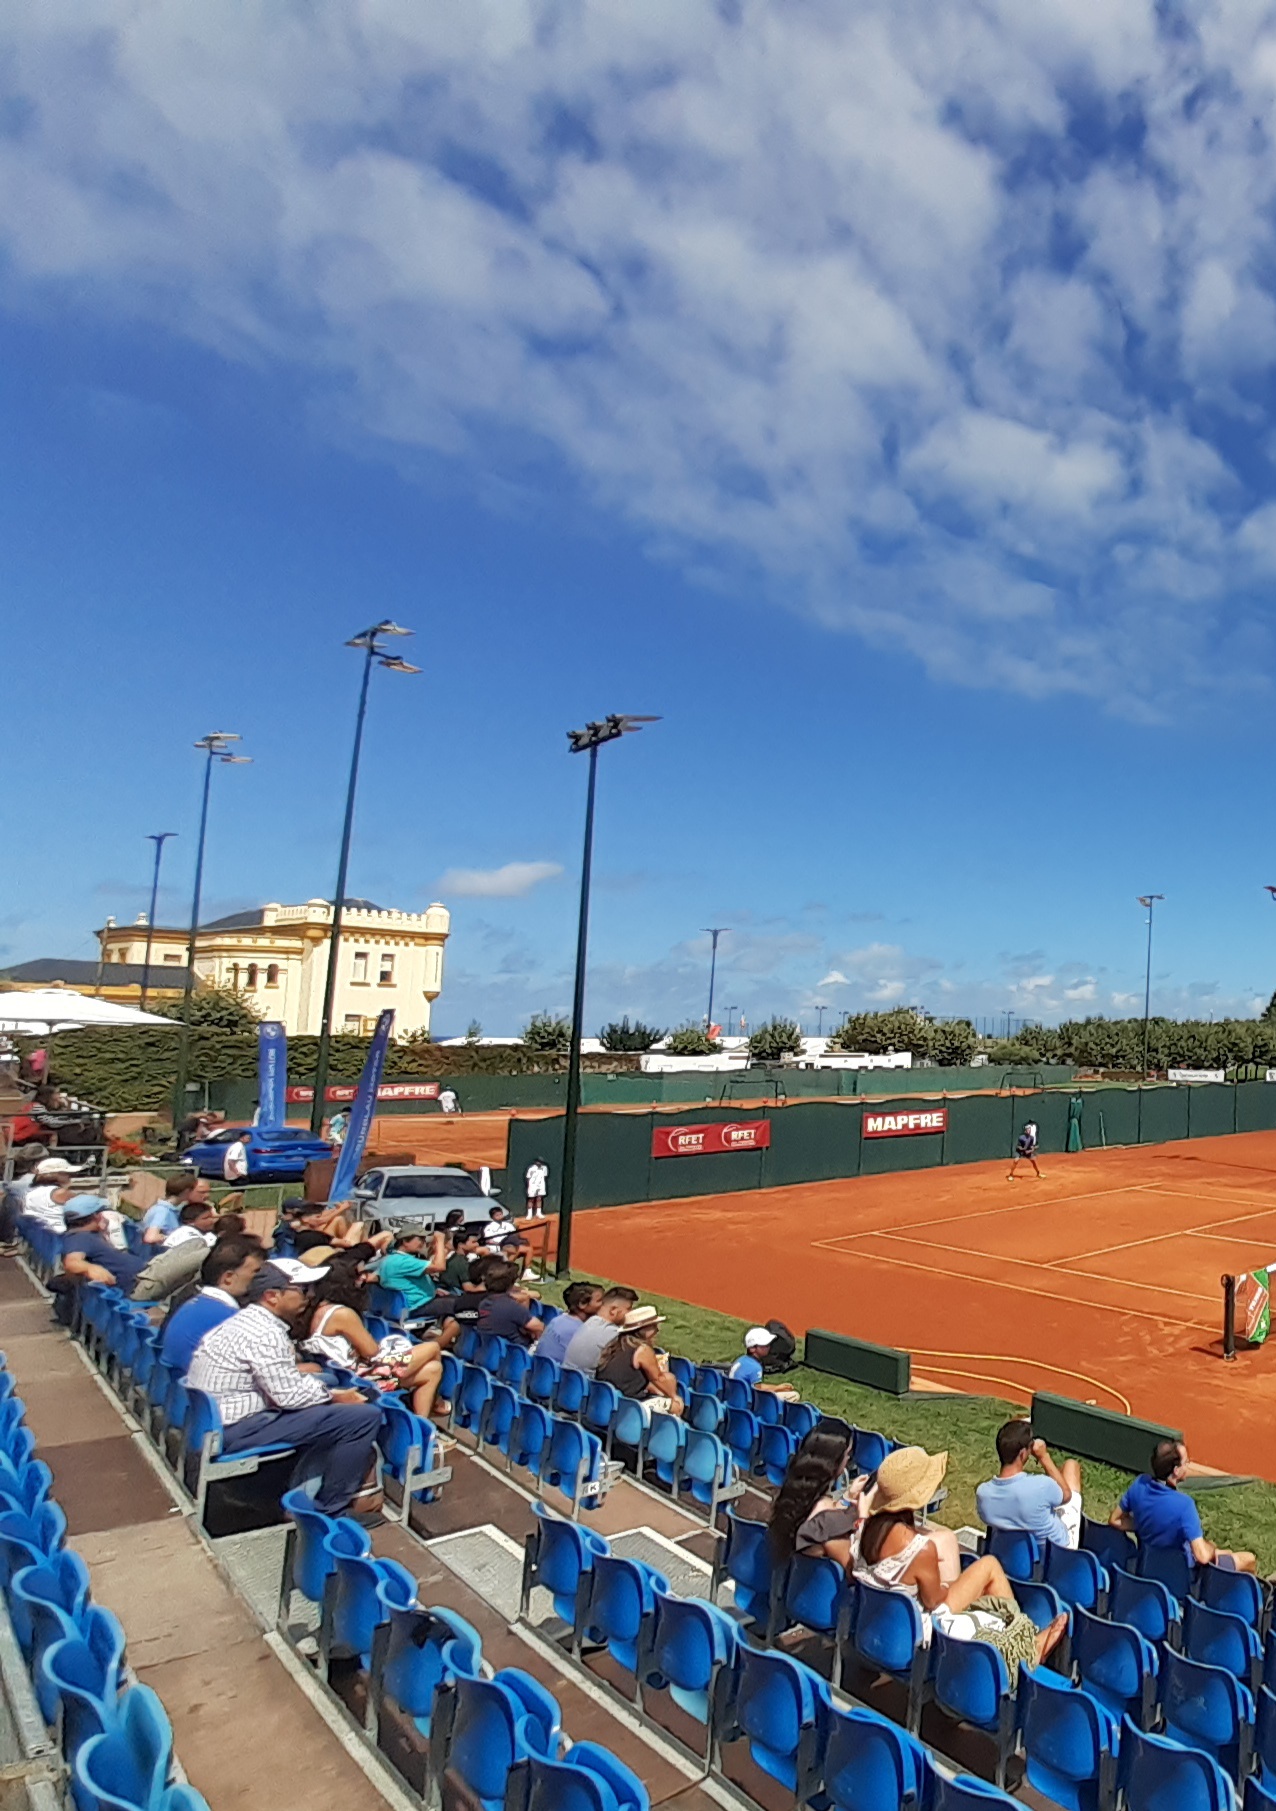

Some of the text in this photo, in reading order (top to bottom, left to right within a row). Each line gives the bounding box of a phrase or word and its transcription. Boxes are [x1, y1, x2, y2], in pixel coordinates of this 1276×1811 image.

[867, 1112, 944, 1132] MAPFRE
[678, 1134, 704, 1145] RFET
[731, 1130, 756, 1141] RFET
